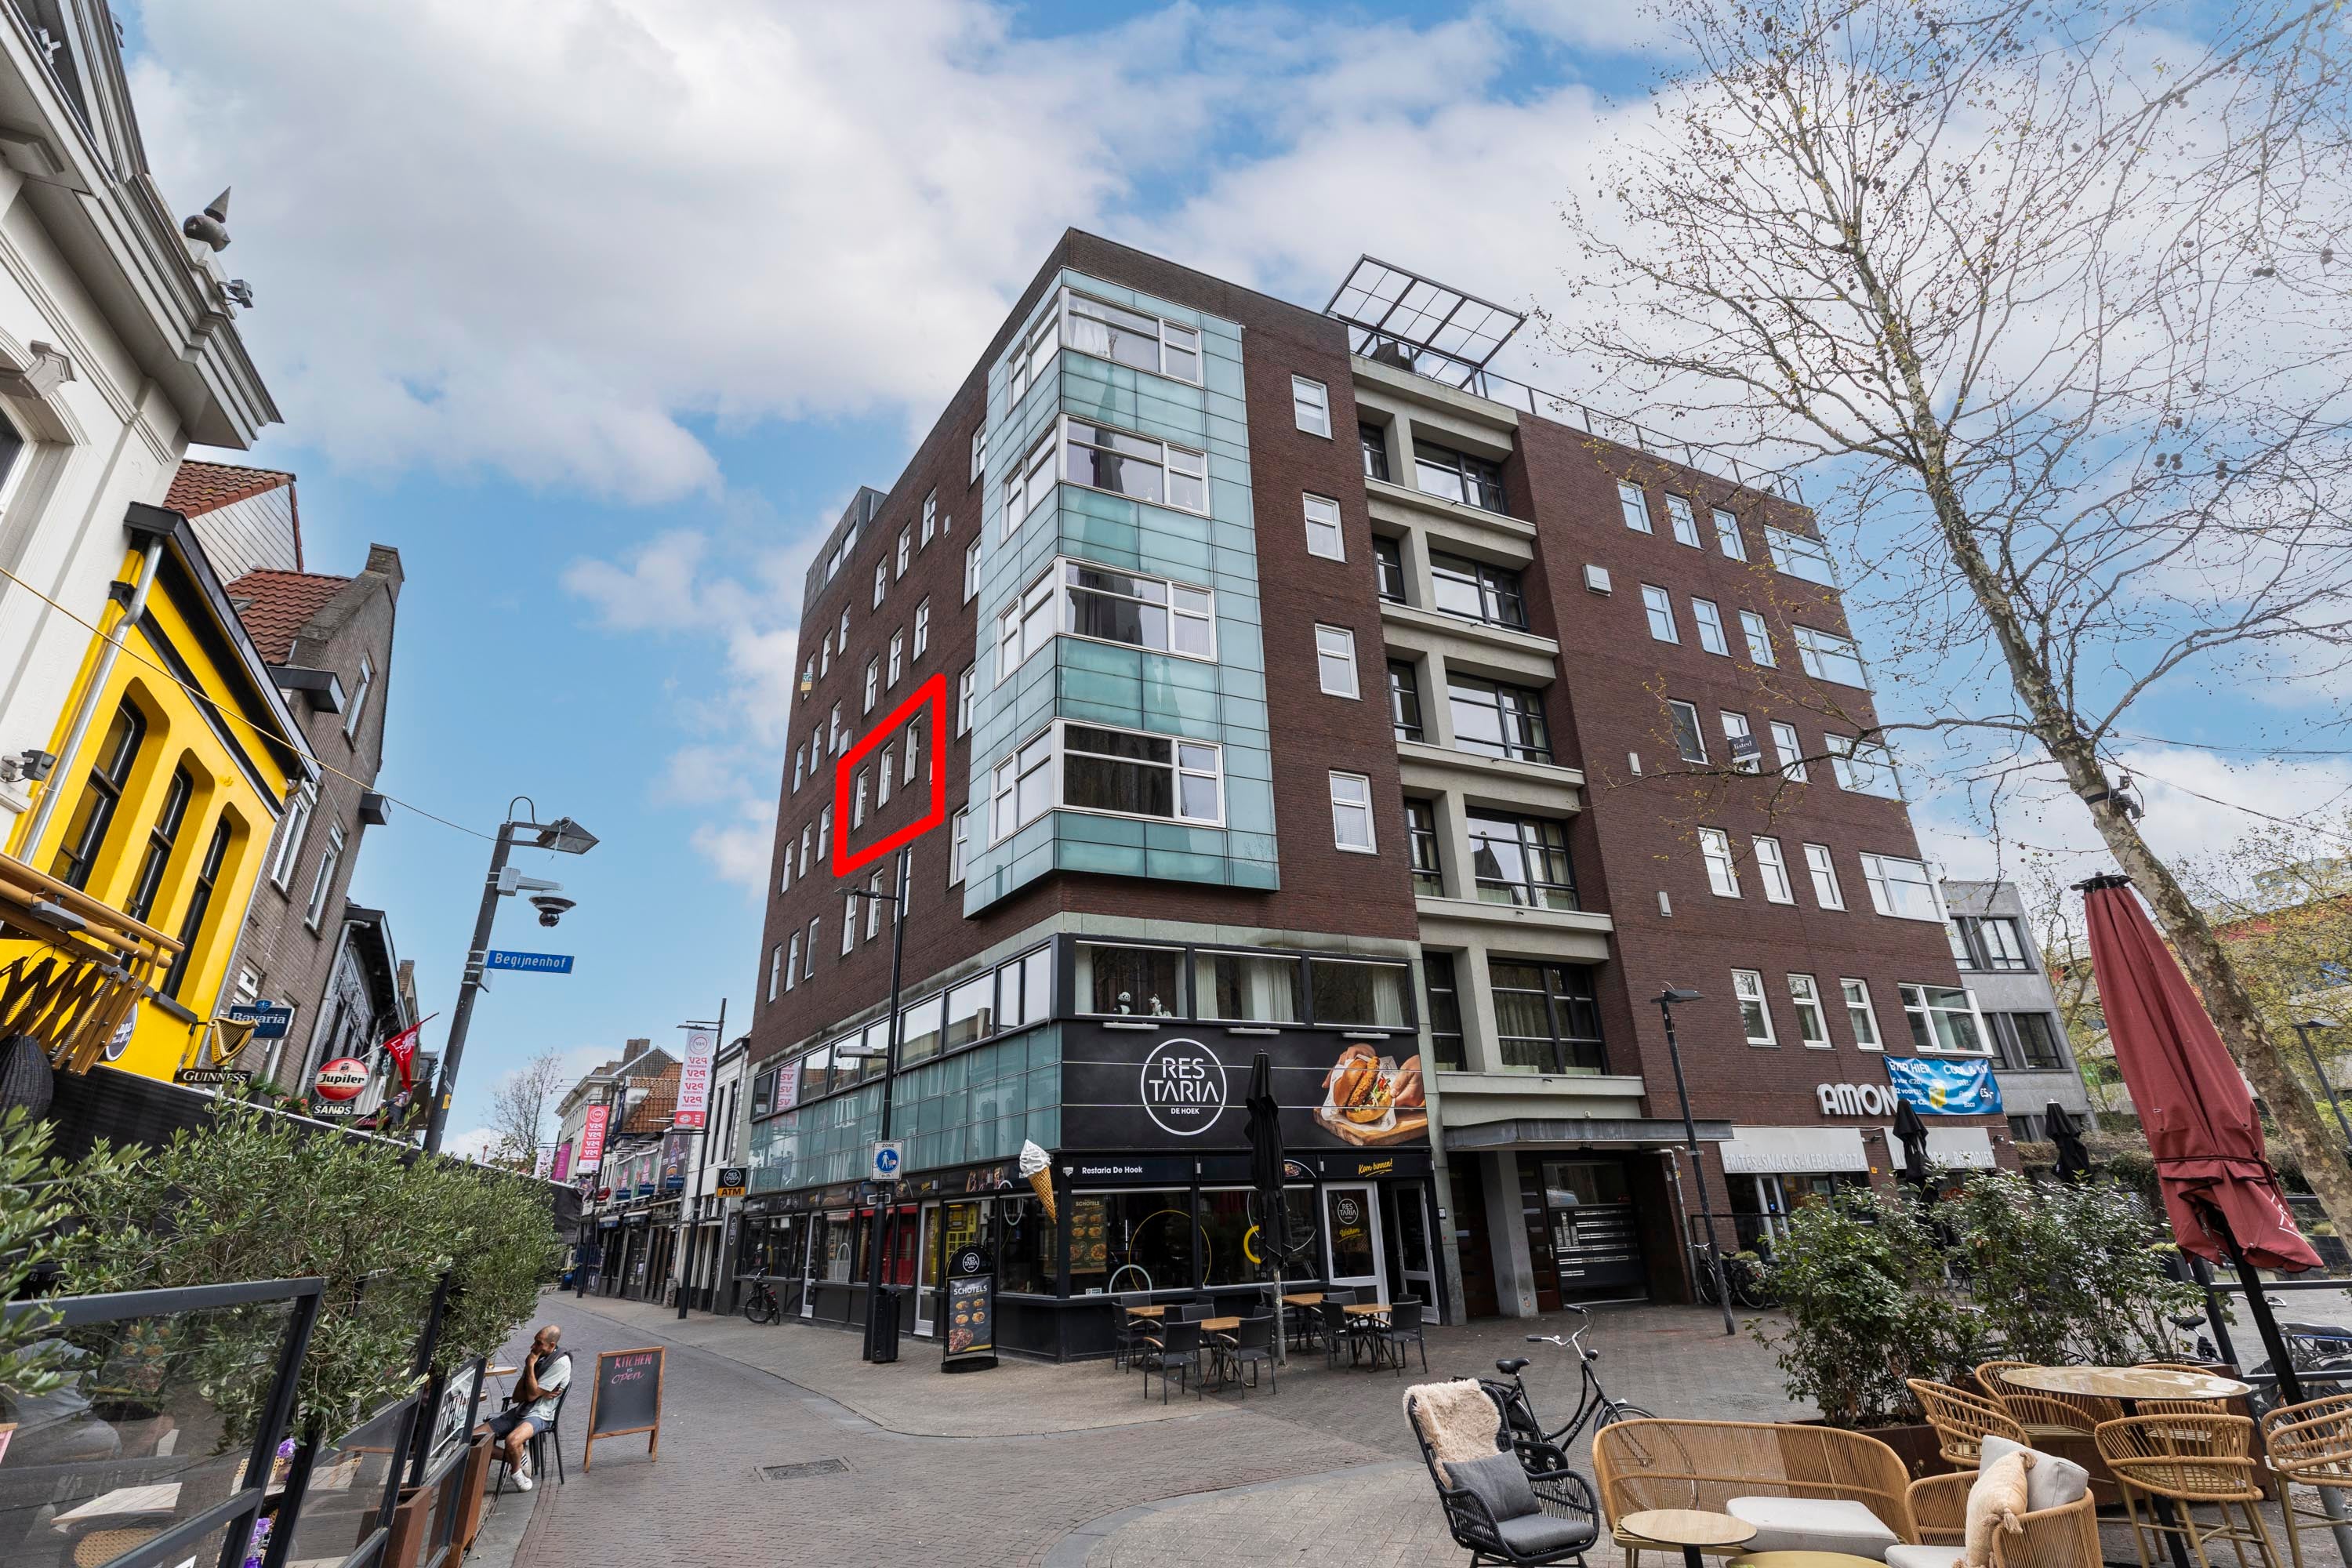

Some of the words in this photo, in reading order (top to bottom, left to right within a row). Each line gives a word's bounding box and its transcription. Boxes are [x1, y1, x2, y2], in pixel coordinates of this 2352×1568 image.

[494, 953, 567, 967] Begijnenhof
[232, 1012, 286, 1024] Bavaria
[1162, 1057, 1206, 1080] RES
[183, 1070, 247, 1083] GUINNESS
[318, 1073, 365, 1085] Jupiler
[1149, 1080, 1219, 1102] TARIA
[314, 1105, 352, 1115] SANDS
[721, 1188, 742, 1196] ATM
[953, 1284, 988, 1295] SCHOTELS
[614, 1353, 653, 1370] KITCHEN
